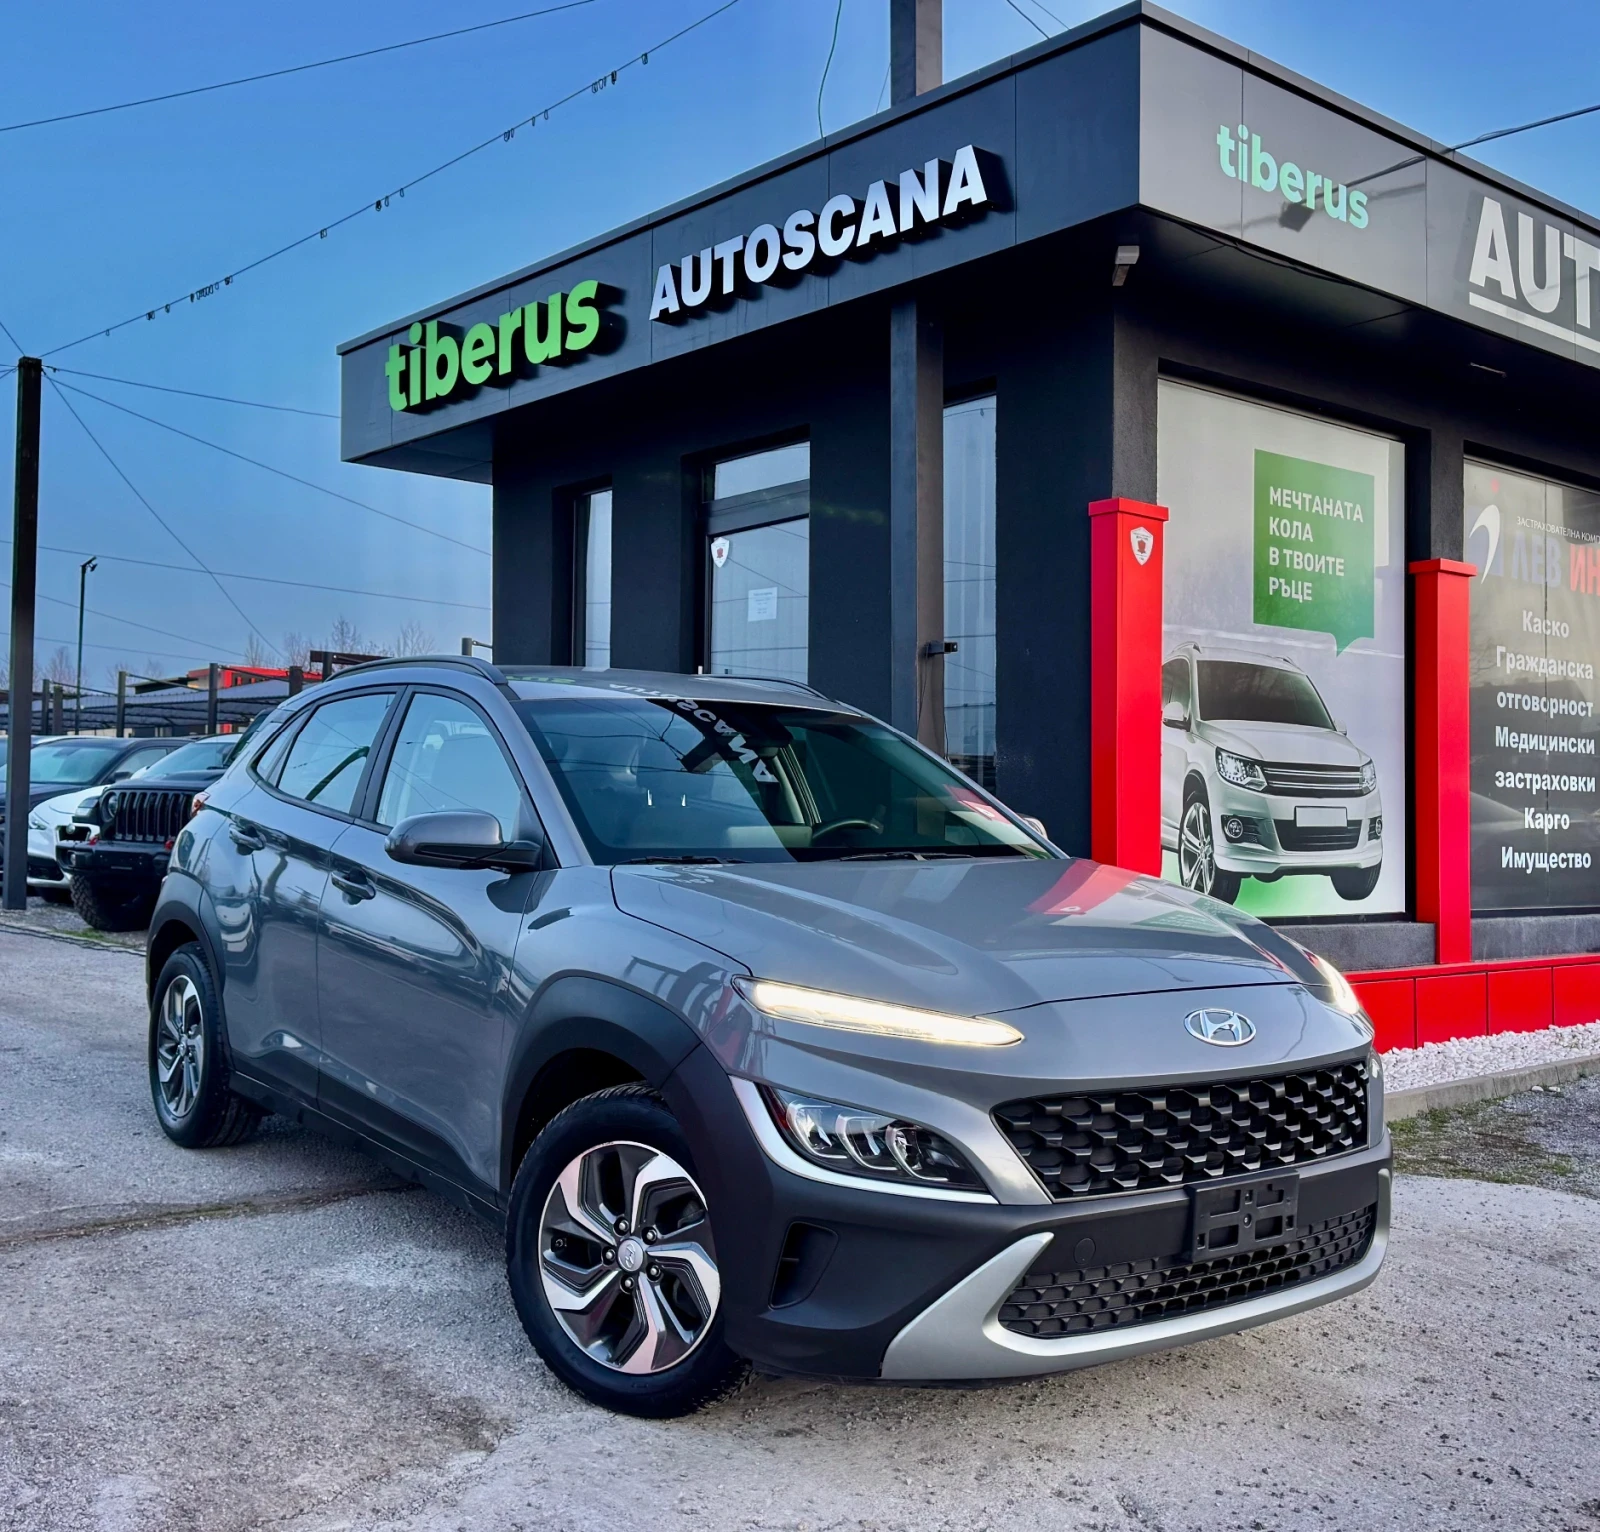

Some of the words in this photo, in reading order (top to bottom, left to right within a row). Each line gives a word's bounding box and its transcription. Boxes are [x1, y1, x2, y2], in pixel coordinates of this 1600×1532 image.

[1216, 123, 1370, 230] tiberus
[649, 143, 988, 321] AUTOSCANA
[1468, 195, 1600, 329] AUT
[385, 279, 600, 412] tiberus
[1269, 486, 1364, 523] МЕЧТАНАТА
[1269, 516, 1314, 543] КОЛА
[1516, 515, 1581, 540] ЗАСТРАХОВАТЕЛНА
[1269, 547, 1280, 566] В
[1283, 549, 1345, 577] ТВОИТЕ
[1511, 530, 1562, 588] ЛЕВ
[1268, 577, 1313, 603] РЪЦЕ
[1522, 610, 1570, 638] Каско
[1496, 645, 1594, 680] Гражданска
[1496, 691, 1594, 718] отговорност
[1495, 725, 1596, 755] Медицински
[1494, 770, 1596, 795] застраховки
[1524, 807, 1570, 834] Карго
[1501, 846, 1592, 874] Имущество
